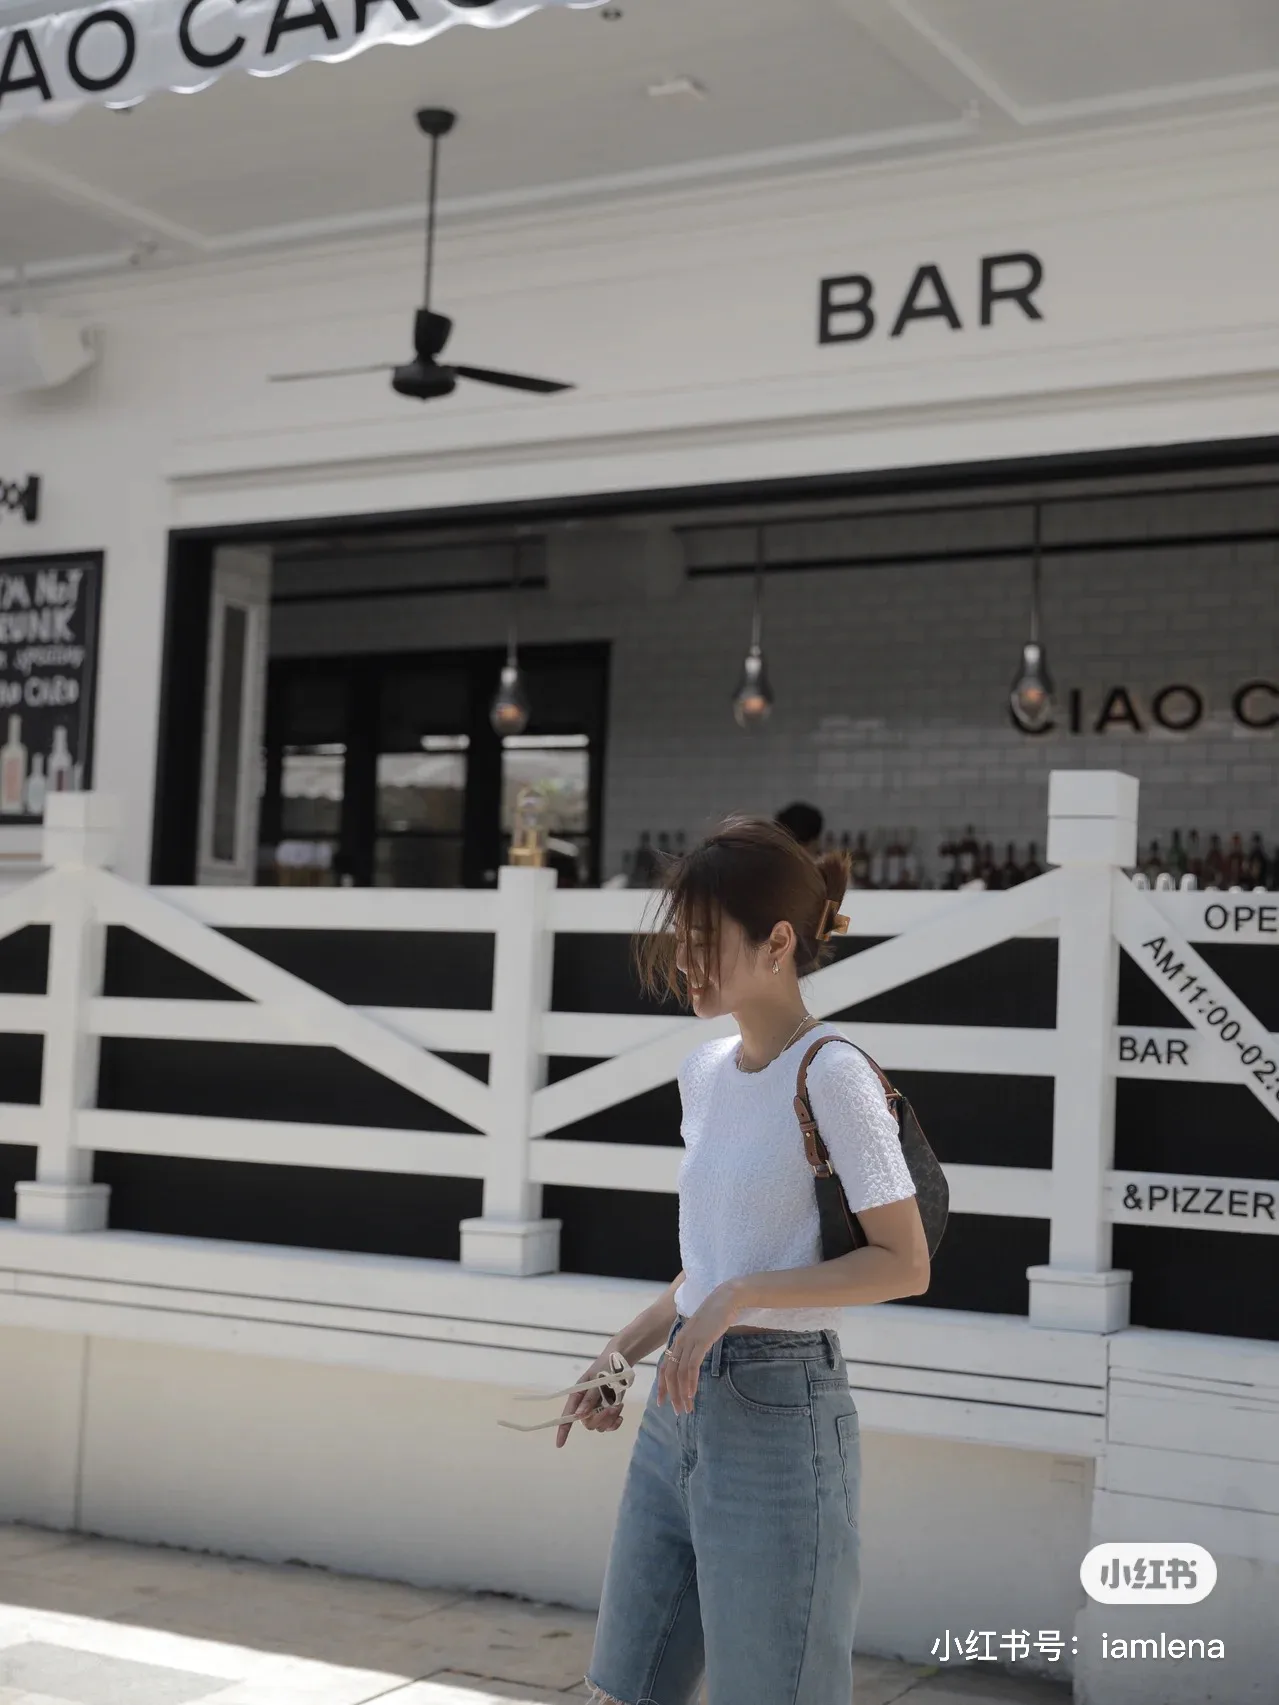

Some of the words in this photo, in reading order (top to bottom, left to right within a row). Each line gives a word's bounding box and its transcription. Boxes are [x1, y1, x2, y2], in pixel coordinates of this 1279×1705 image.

[0, 10, 135, 101] AO
[817, 252, 1043, 344] BAR
[1204, 904, 1278, 932] OPE
[1119, 1036, 1189, 1066] BAR
